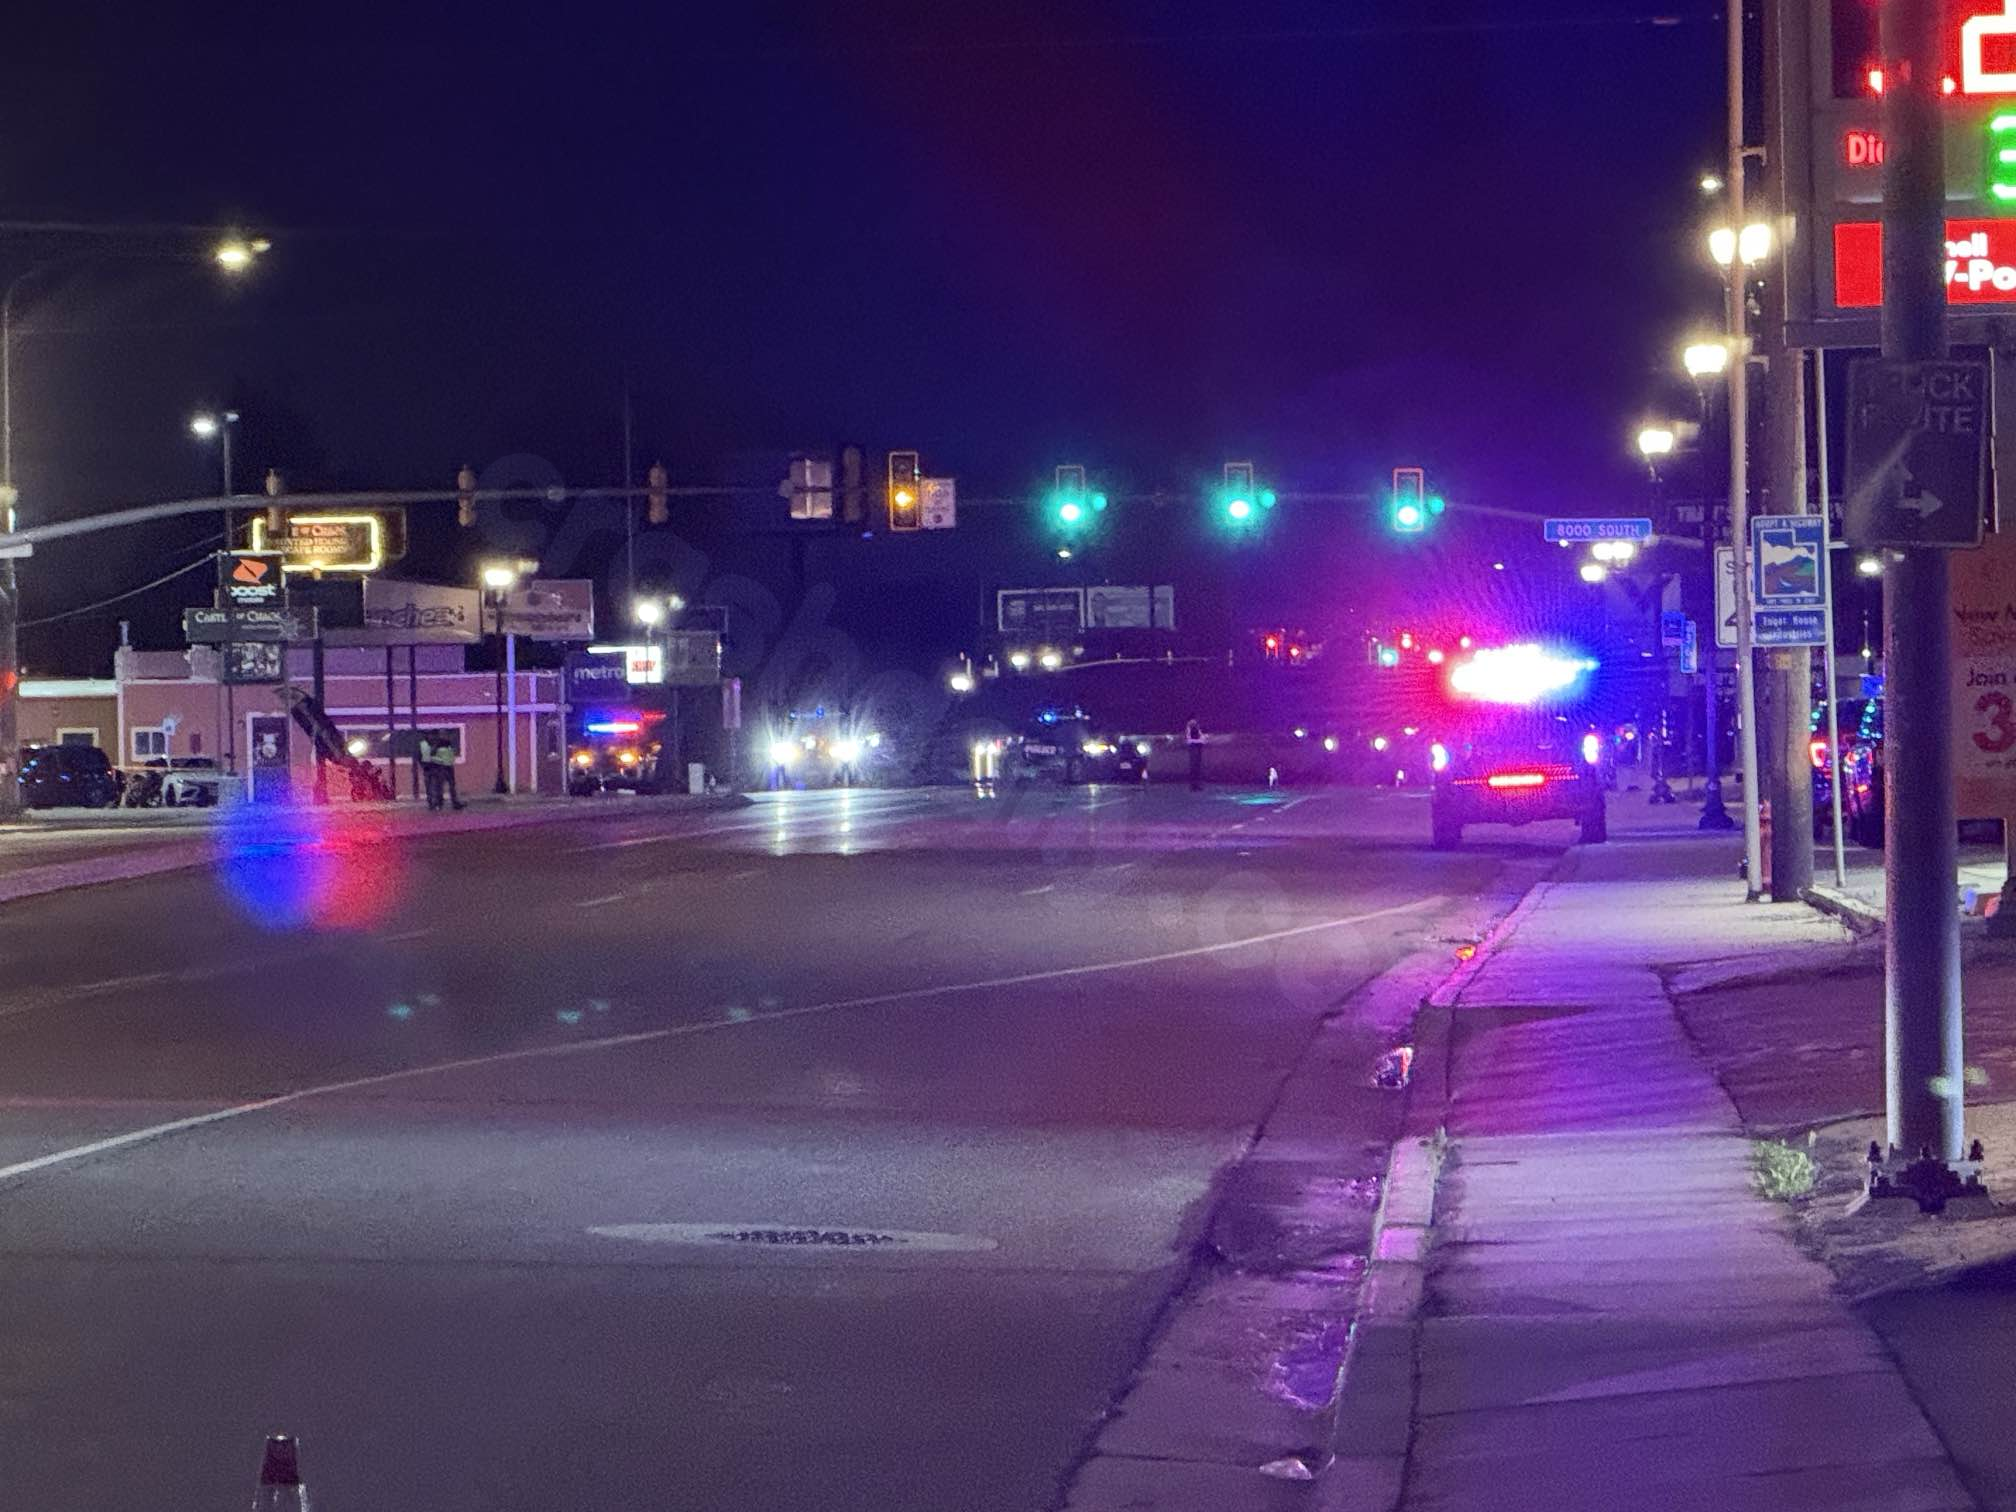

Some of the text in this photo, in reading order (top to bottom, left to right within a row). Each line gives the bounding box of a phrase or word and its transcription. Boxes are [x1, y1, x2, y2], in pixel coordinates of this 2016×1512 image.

[1557, 524, 1640, 537] 8000 SOUTH
[574, 664, 624, 680] metro
